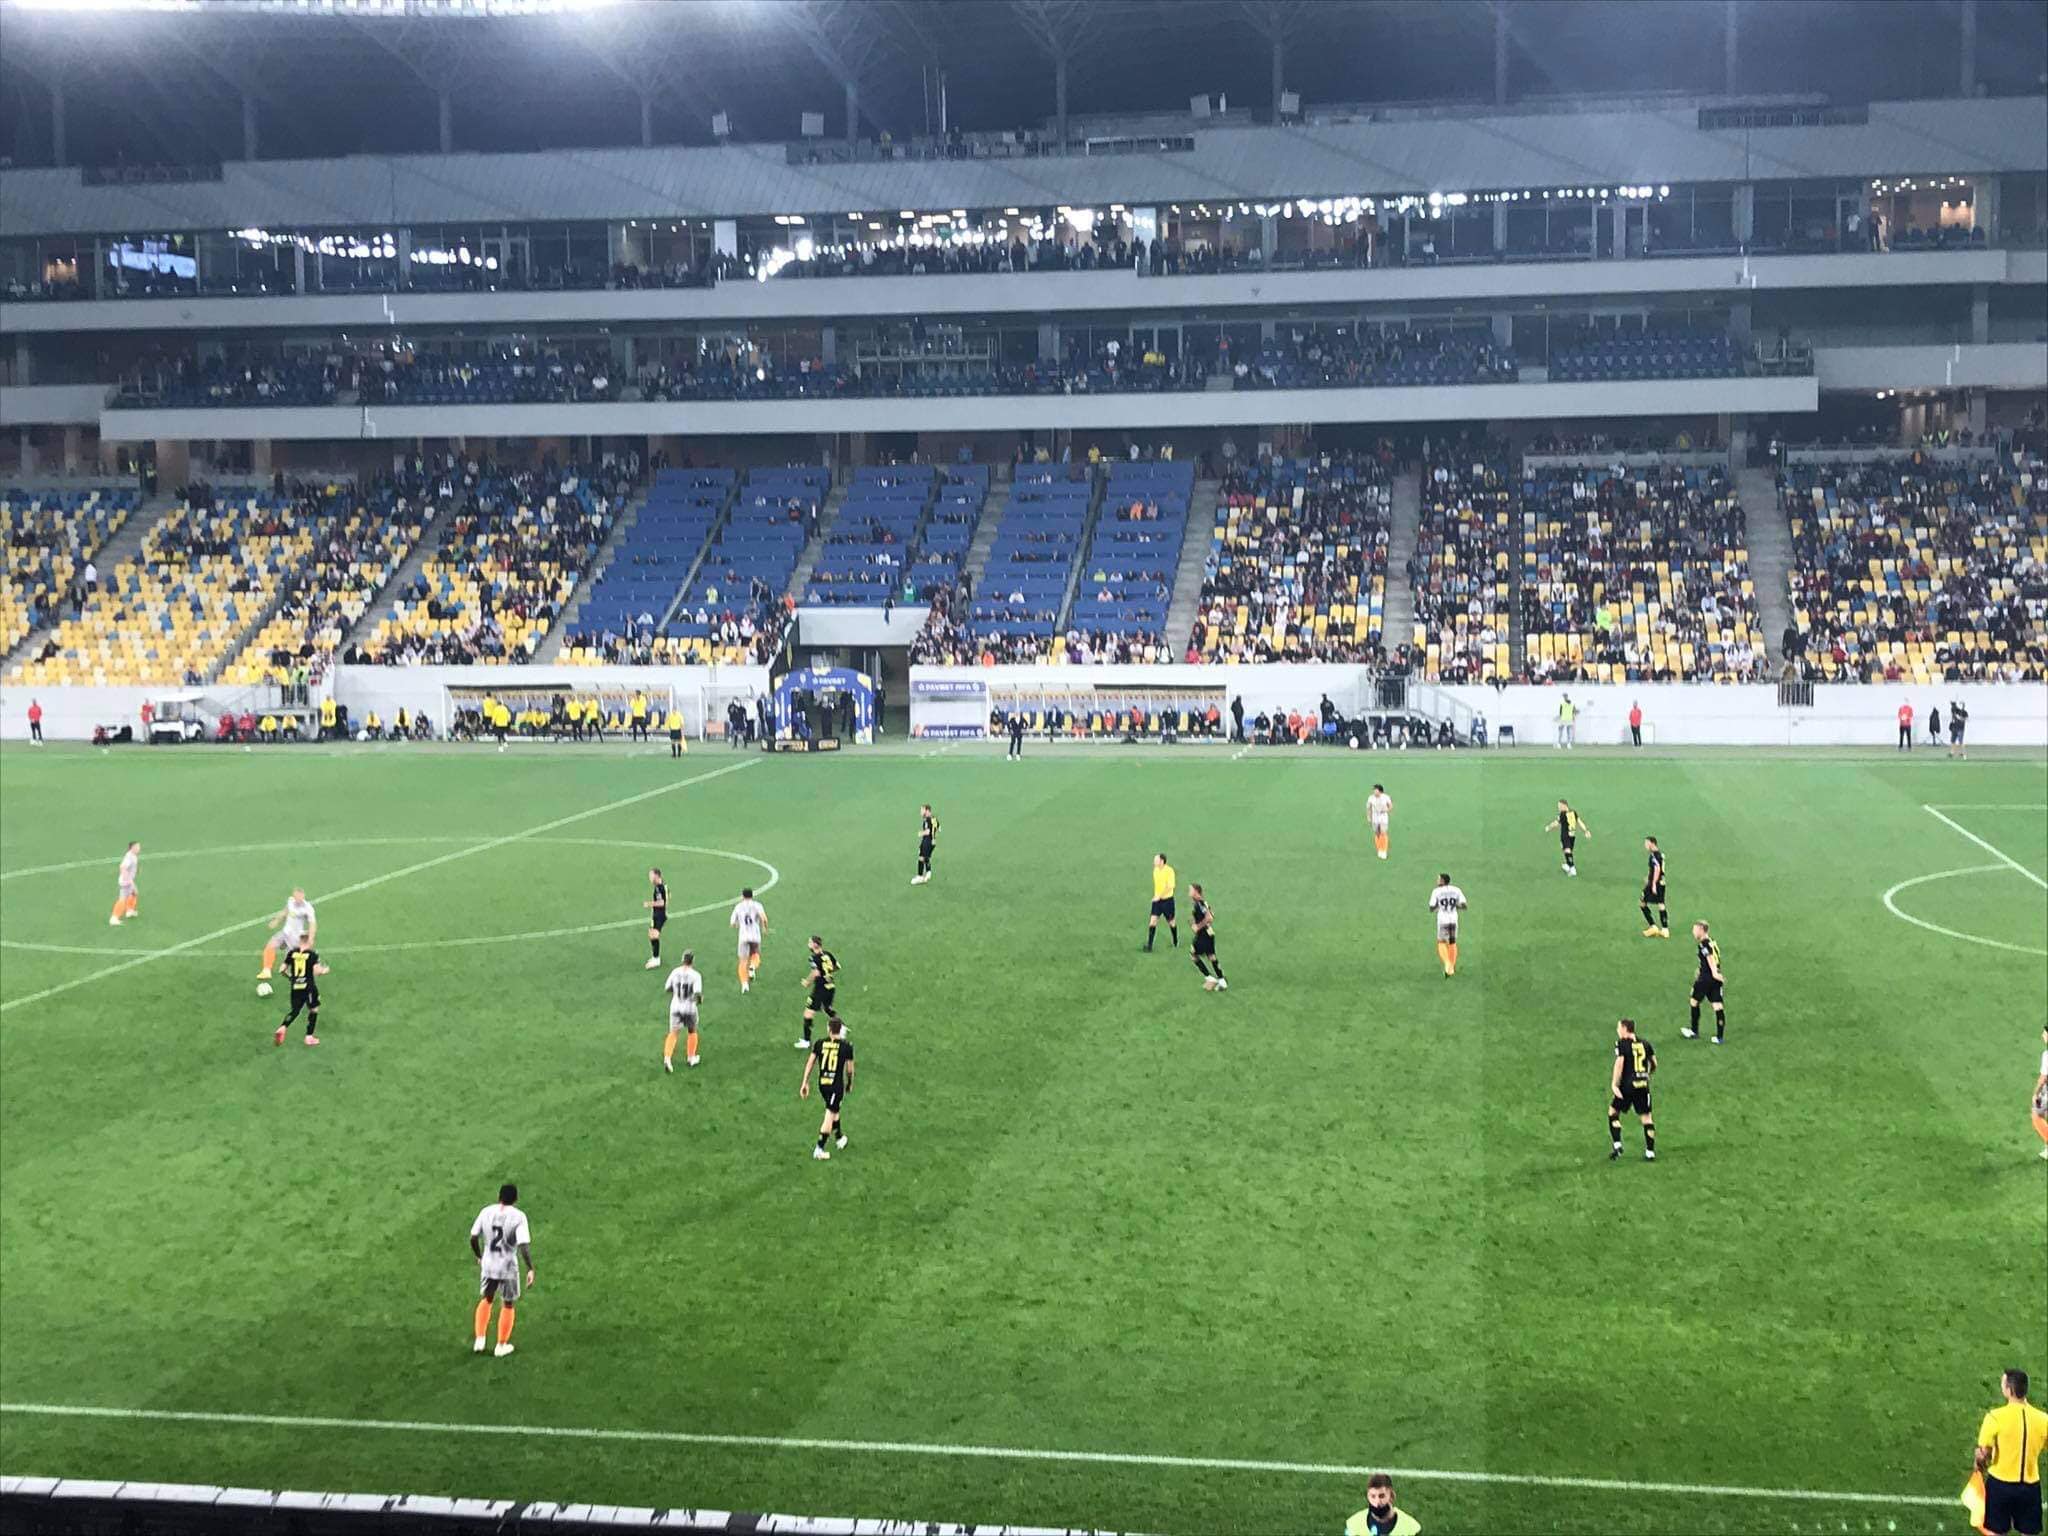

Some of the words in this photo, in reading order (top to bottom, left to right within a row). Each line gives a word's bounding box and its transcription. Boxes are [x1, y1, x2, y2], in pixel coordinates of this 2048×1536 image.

[1440, 897, 1456, 911] 99
[821, 1049, 839, 1071] 76
[1632, 1050, 1646, 1073] 12
[490, 1225, 504, 1252] 2
